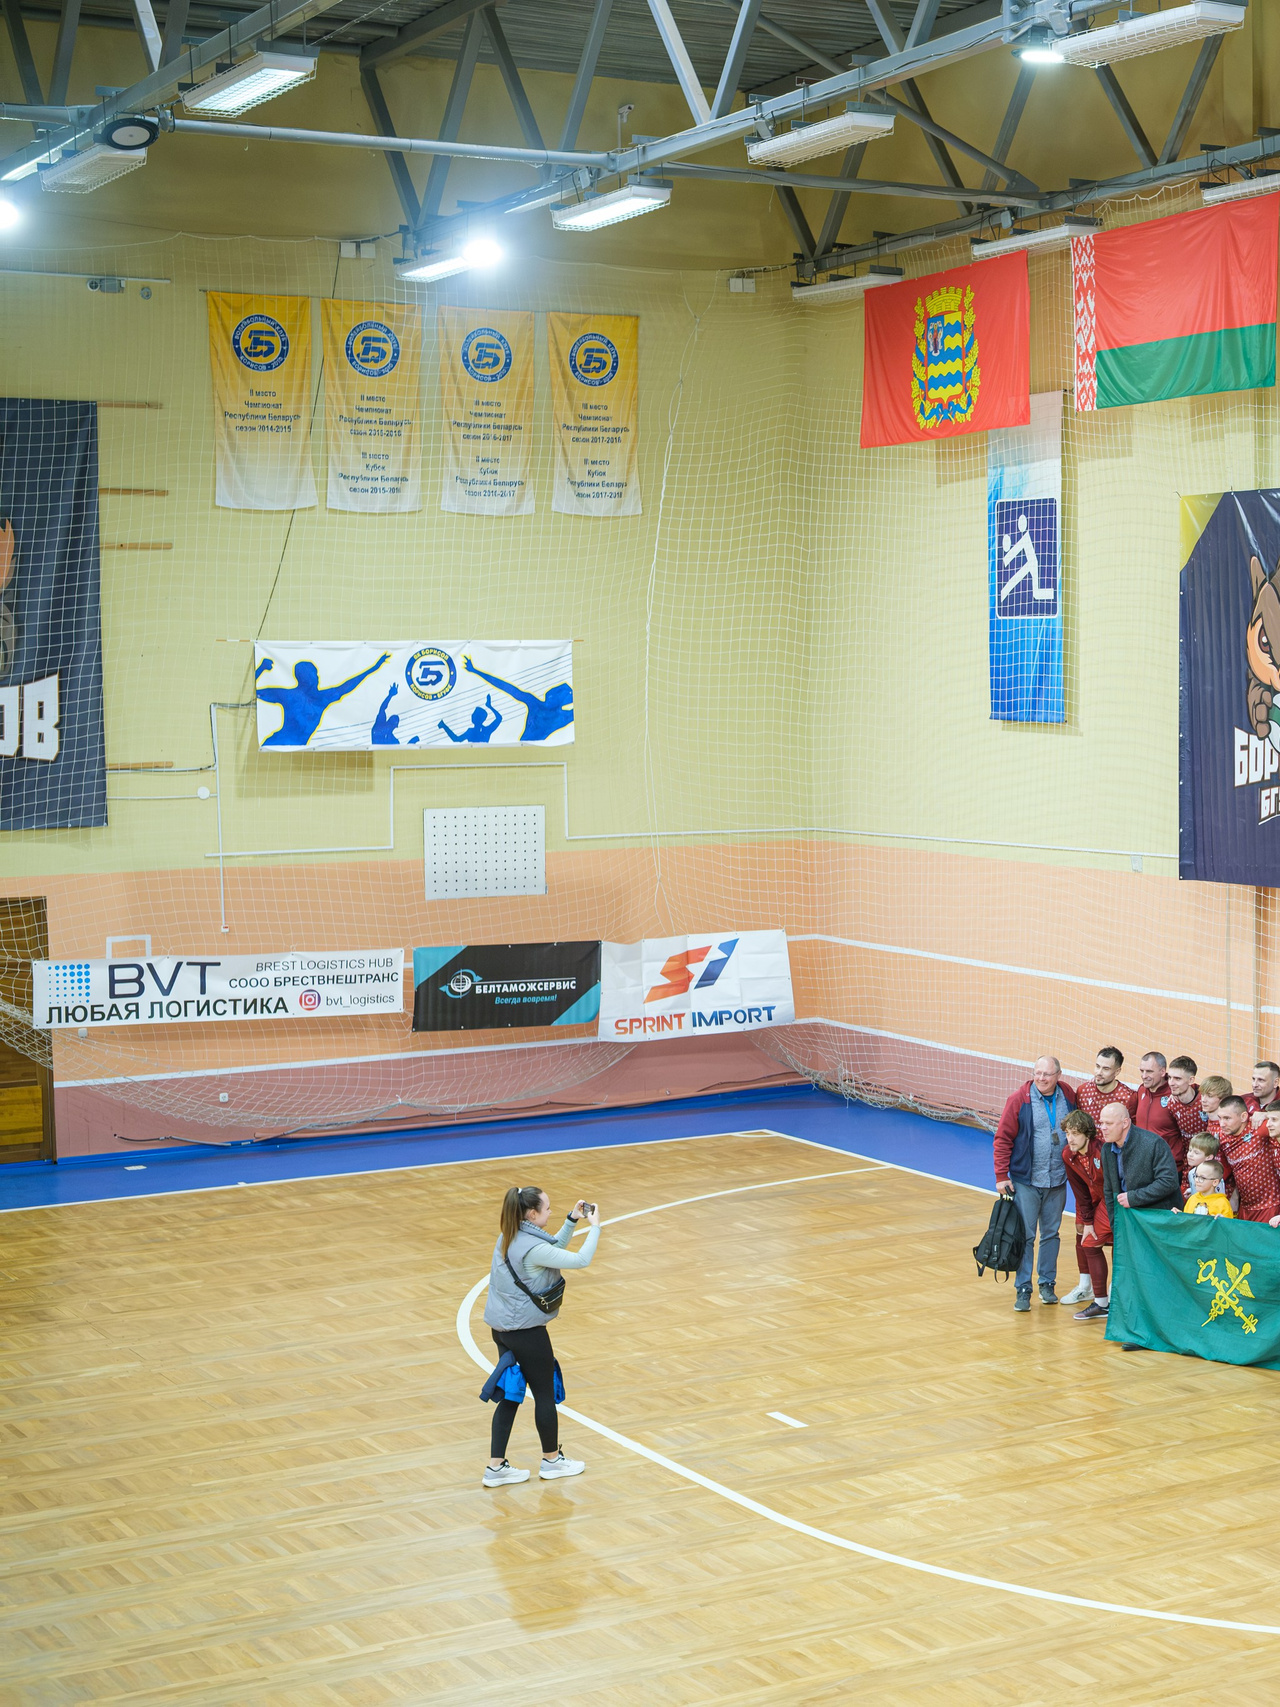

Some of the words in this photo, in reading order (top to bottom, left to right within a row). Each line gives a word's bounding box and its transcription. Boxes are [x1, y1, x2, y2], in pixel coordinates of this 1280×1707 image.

[224, 411, 266, 421] Республики
[255, 961, 297, 972] BREST
[300, 959, 365, 971] LOGISTICS
[368, 958, 393, 968] HUB
[108, 961, 221, 999] BVT
[273, 972, 399, 987] БРЕСТВНЕШТРАНС
[475, 981, 576, 994] БЕЛТАМОЖСЕРВИС
[326, 993, 395, 1008] bvt_logistics
[494, 996, 521, 1005] Всегда
[522, 994, 558, 1004] вовремя!
[46, 1002, 140, 1025] ЛЮБАЯ
[148, 997, 289, 1019] ЛОГИСТИКА
[614, 1013, 686, 1035] SPRINT
[692, 1006, 776, 1028] IMPORT
